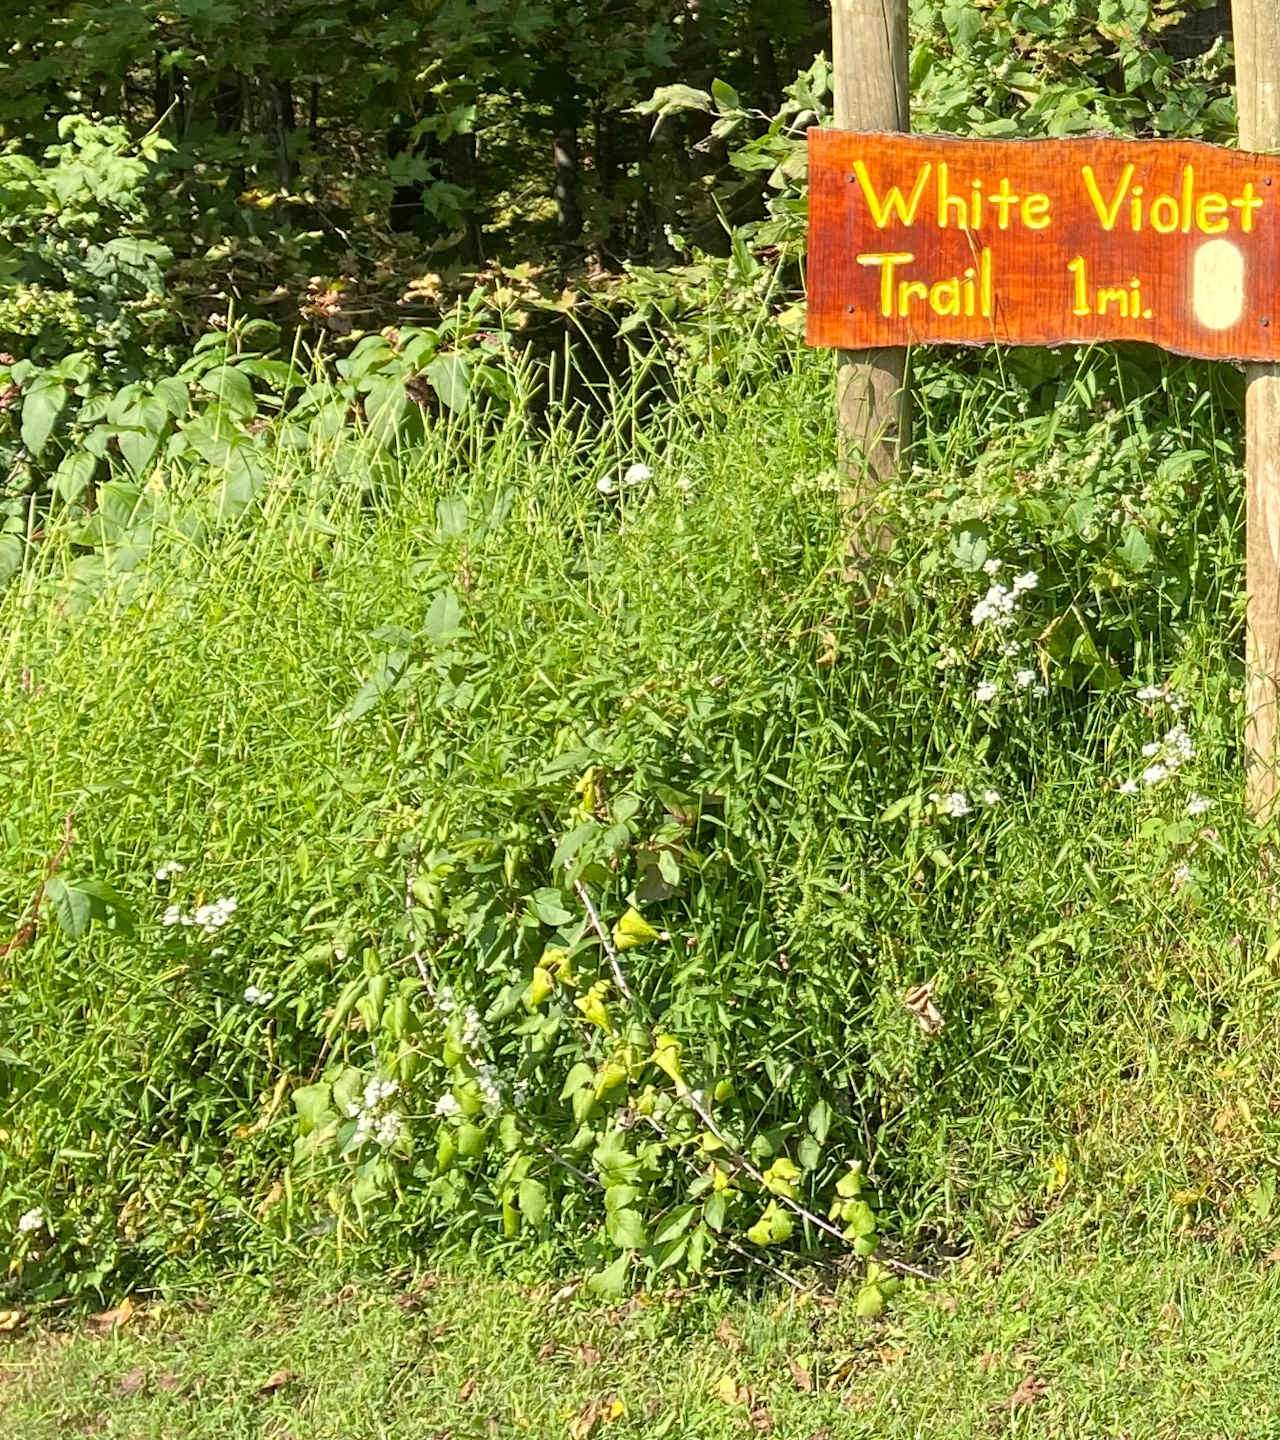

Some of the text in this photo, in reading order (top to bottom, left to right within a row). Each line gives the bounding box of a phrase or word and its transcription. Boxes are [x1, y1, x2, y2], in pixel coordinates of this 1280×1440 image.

[853, 159, 1264, 234] White Violet
[856, 247, 992, 318] Trail
